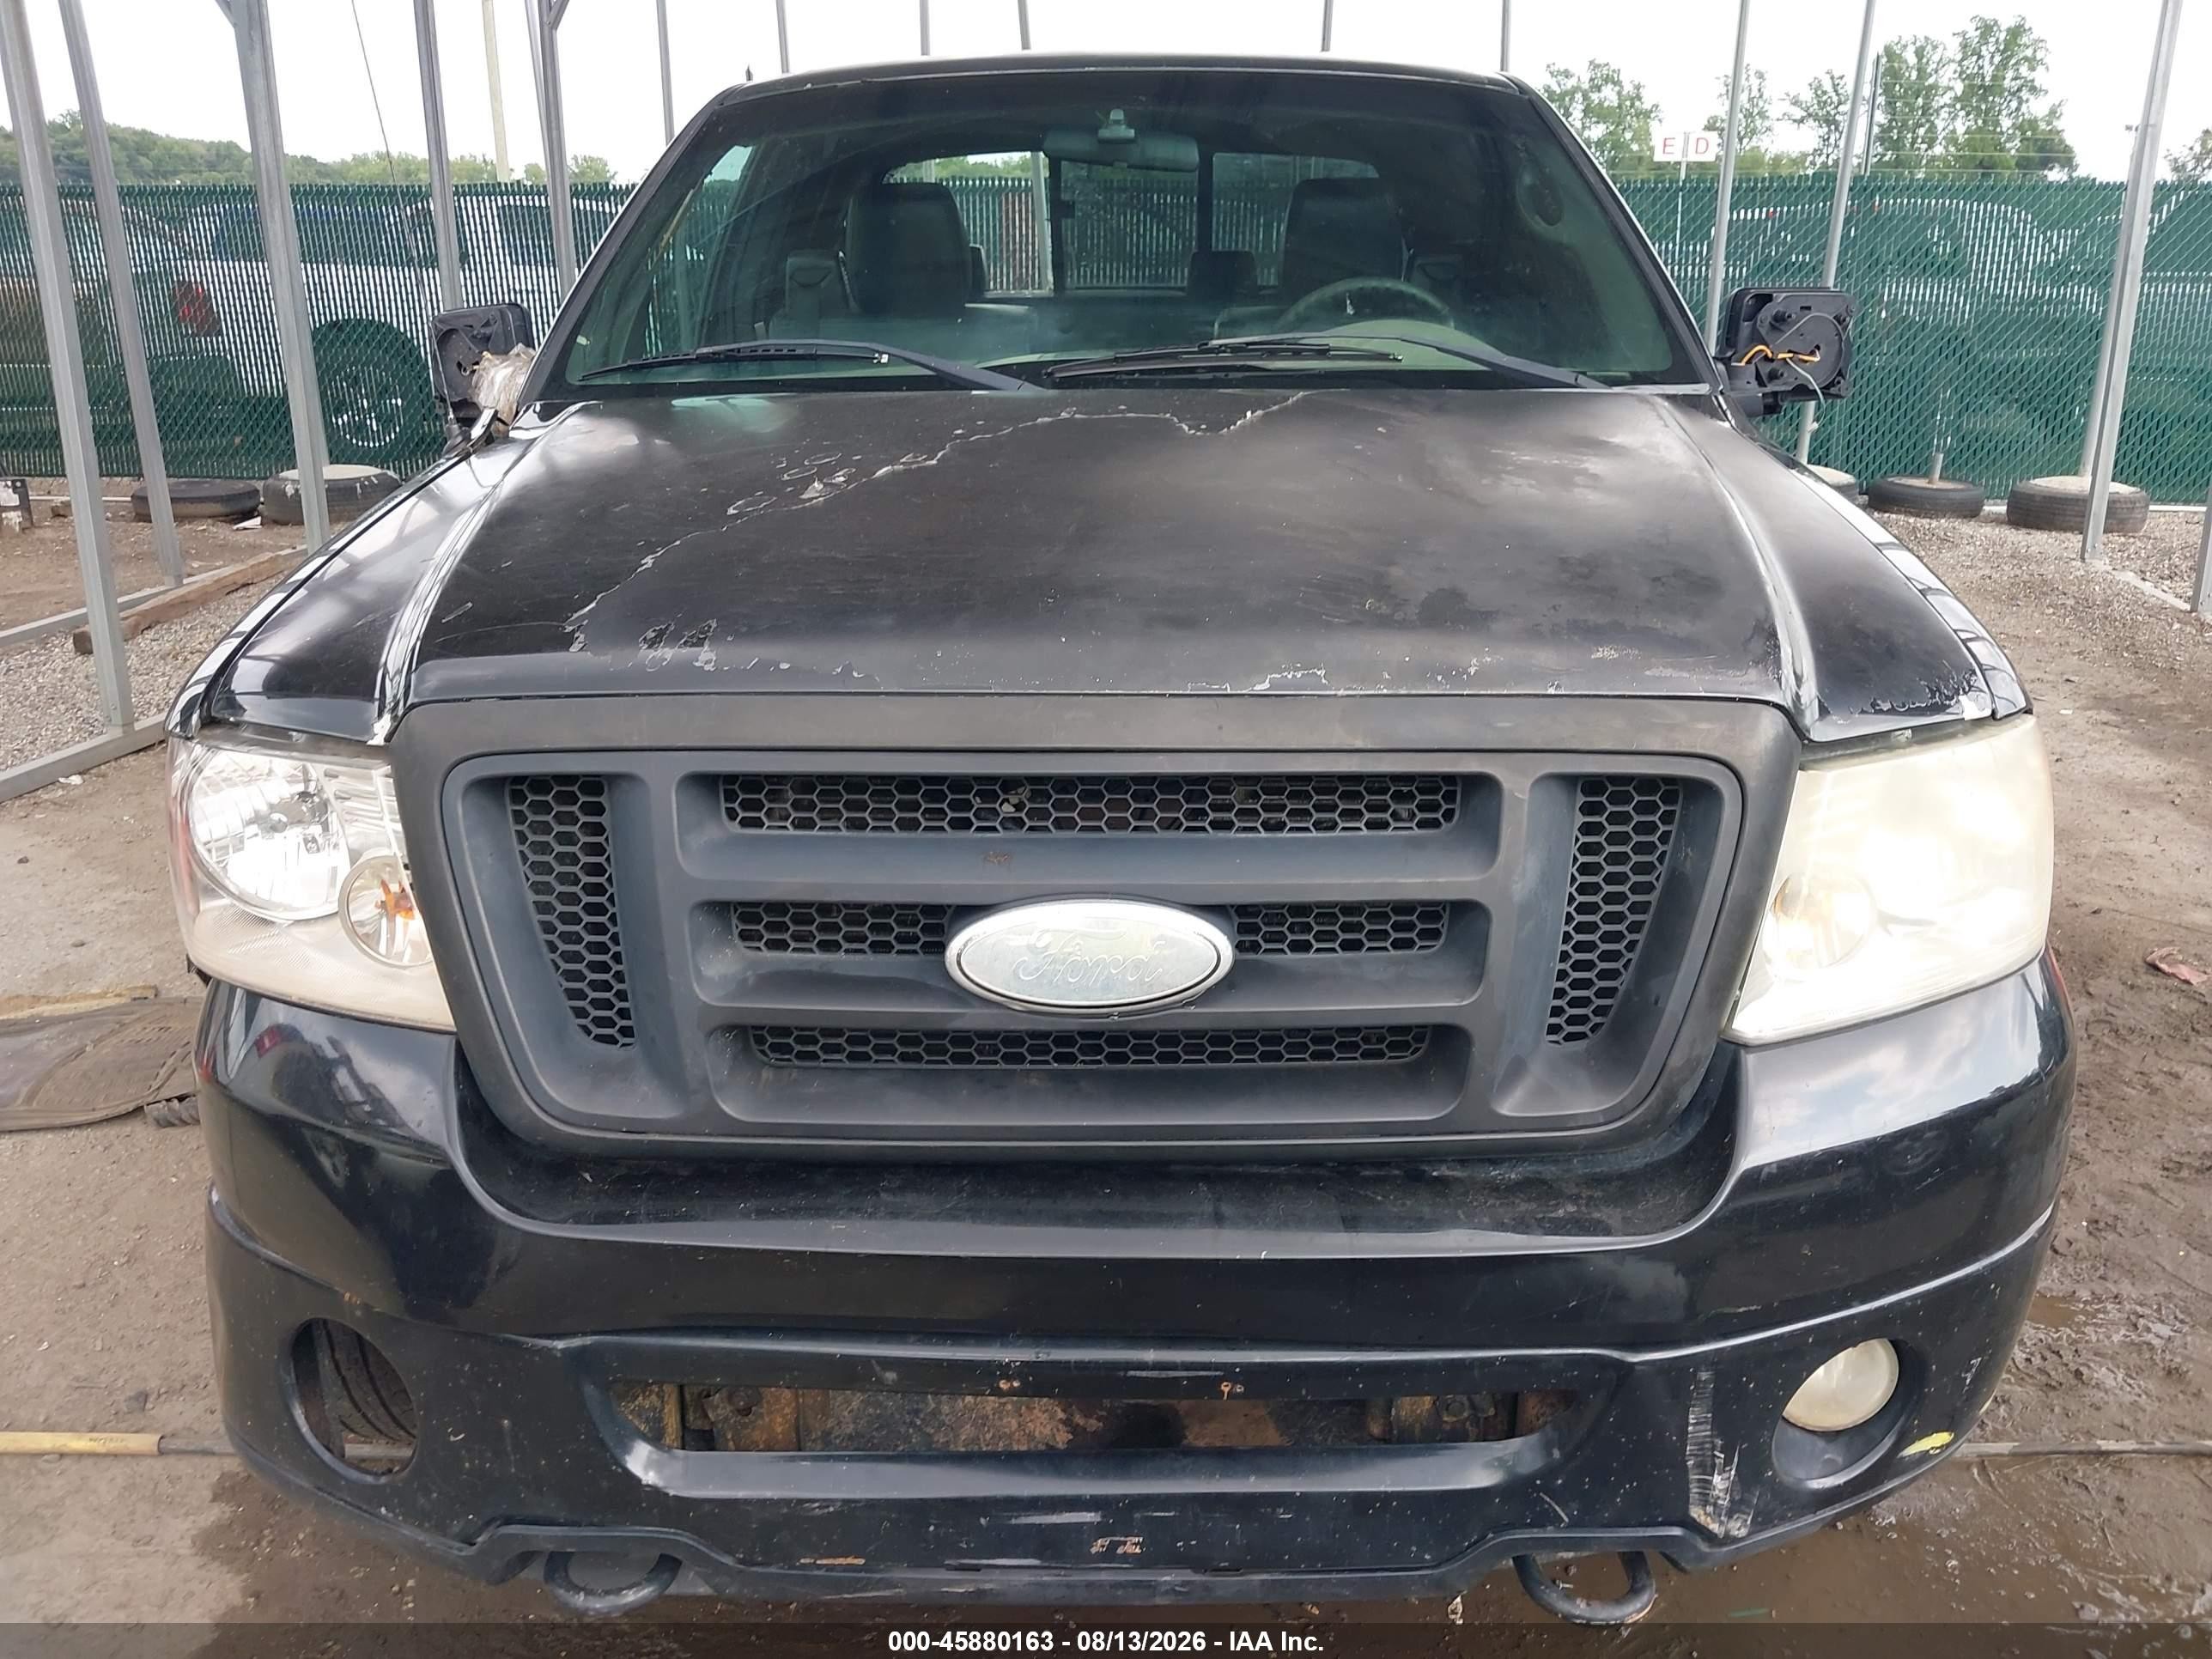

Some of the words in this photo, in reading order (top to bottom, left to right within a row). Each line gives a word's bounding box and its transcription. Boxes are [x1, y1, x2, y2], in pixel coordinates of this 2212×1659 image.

[1663, 137, 1676, 155] E
[1695, 137, 1709, 155] D
[1012, 927, 1166, 986] Ford
